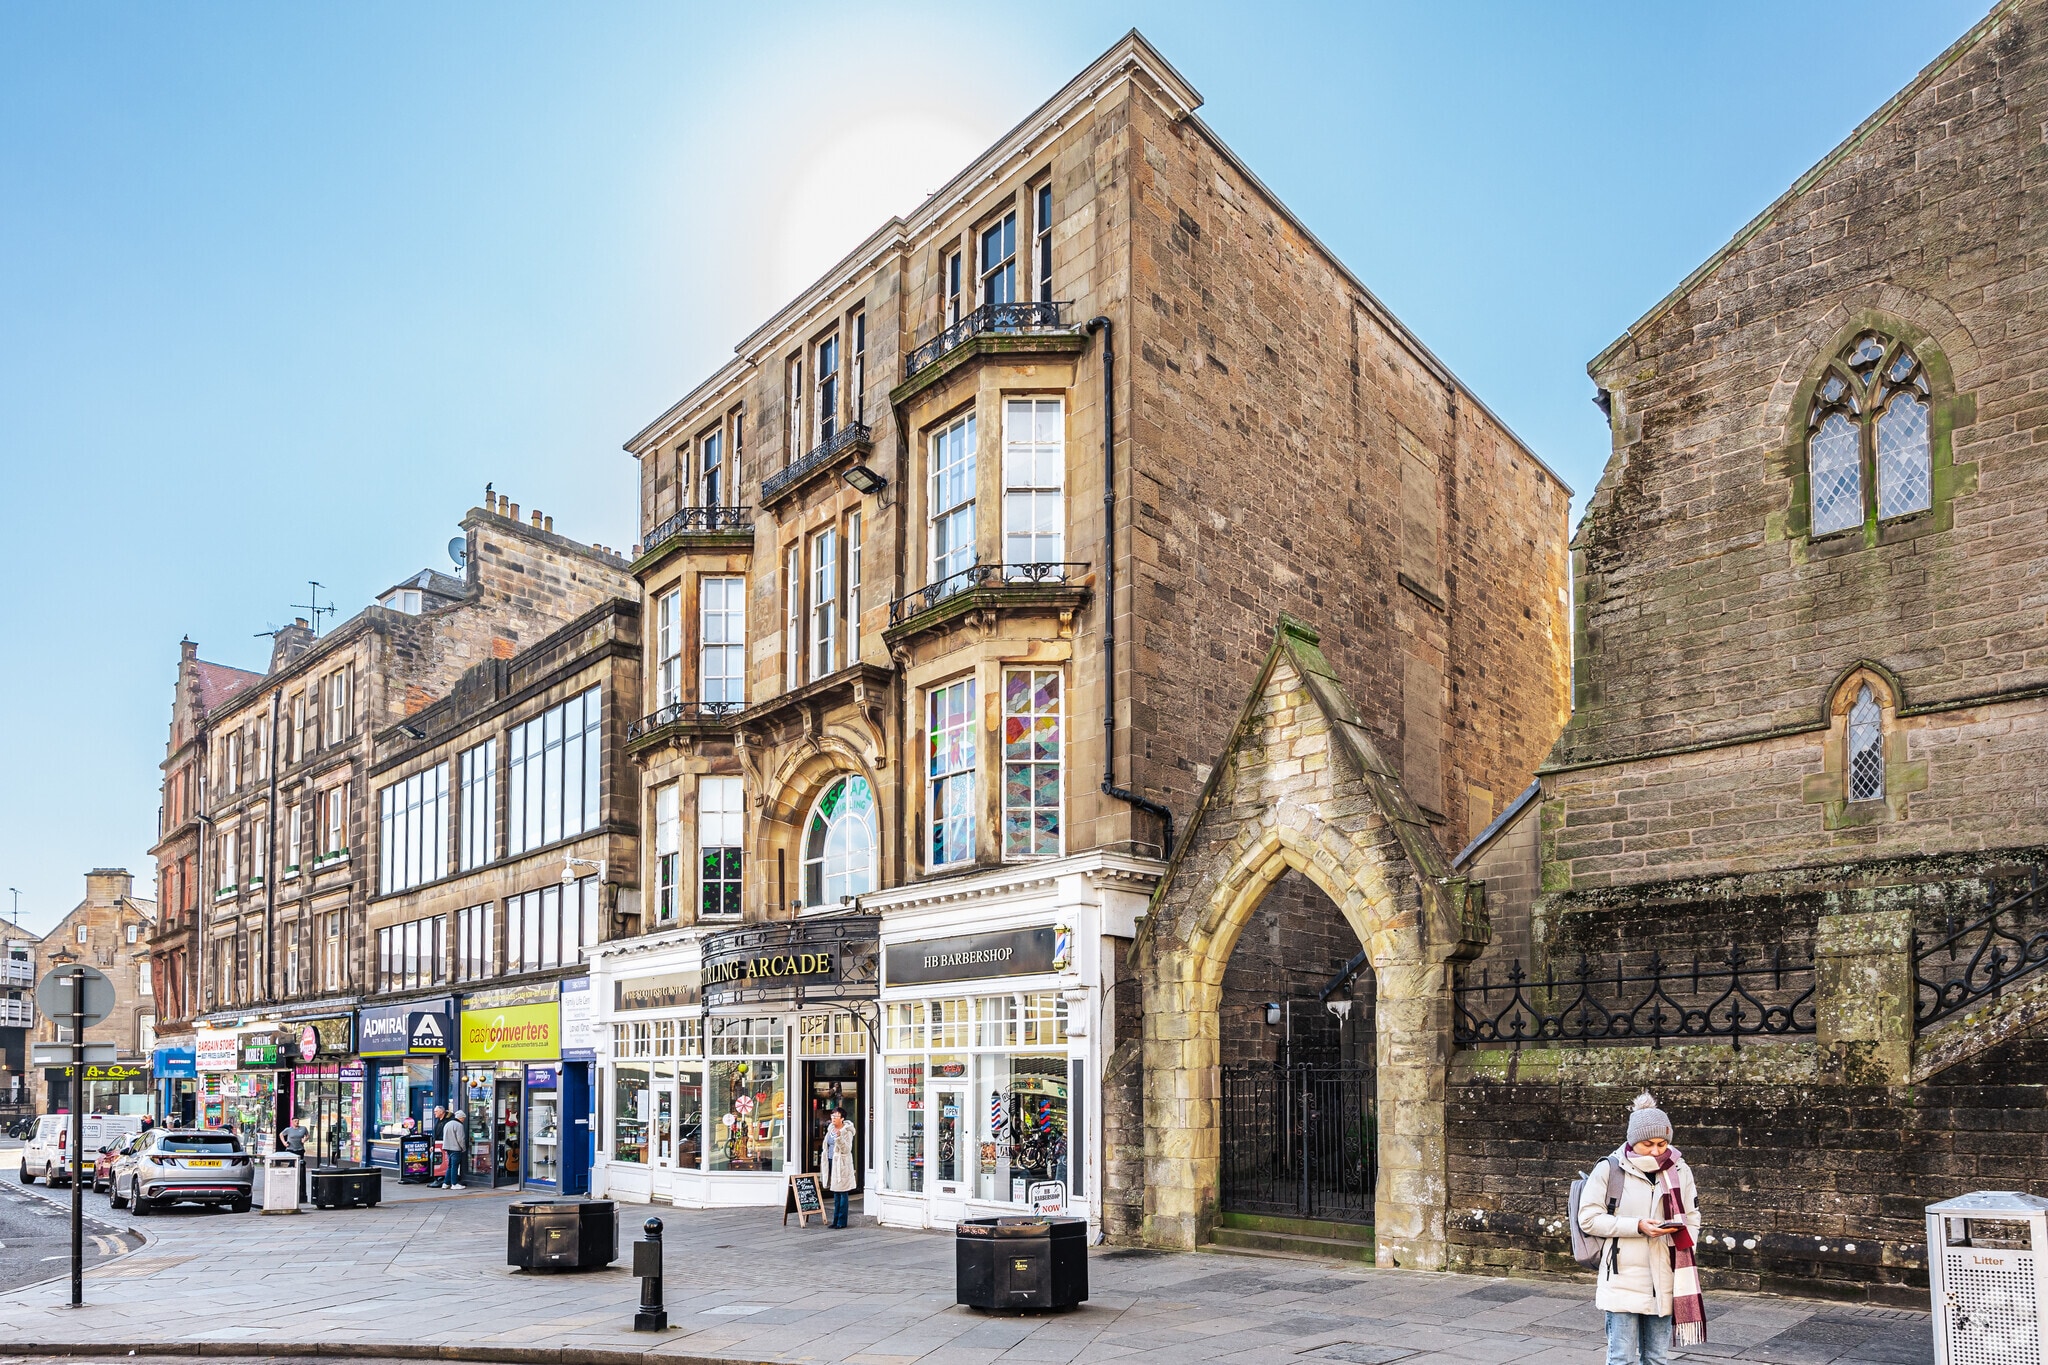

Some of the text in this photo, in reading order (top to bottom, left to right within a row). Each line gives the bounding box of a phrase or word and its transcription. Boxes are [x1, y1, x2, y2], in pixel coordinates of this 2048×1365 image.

[924, 947, 1013, 968] HB BARBERSHOP
[700, 953, 830, 986] TIRLING ARCADE
[363, 1014, 407, 1038] ADMIRAL
[198, 1038, 236, 1052] BARGAIN STORE
[412, 1038, 444, 1046] SLOTS
[888, 1067, 923, 1075] TRADITIONAL
[943, 1064, 962, 1073] OPEN
[945, 1108, 958, 1116] OPEN
[1042, 1204, 1061, 1213] NOW
[1973, 1255, 2005, 1266] Litter
